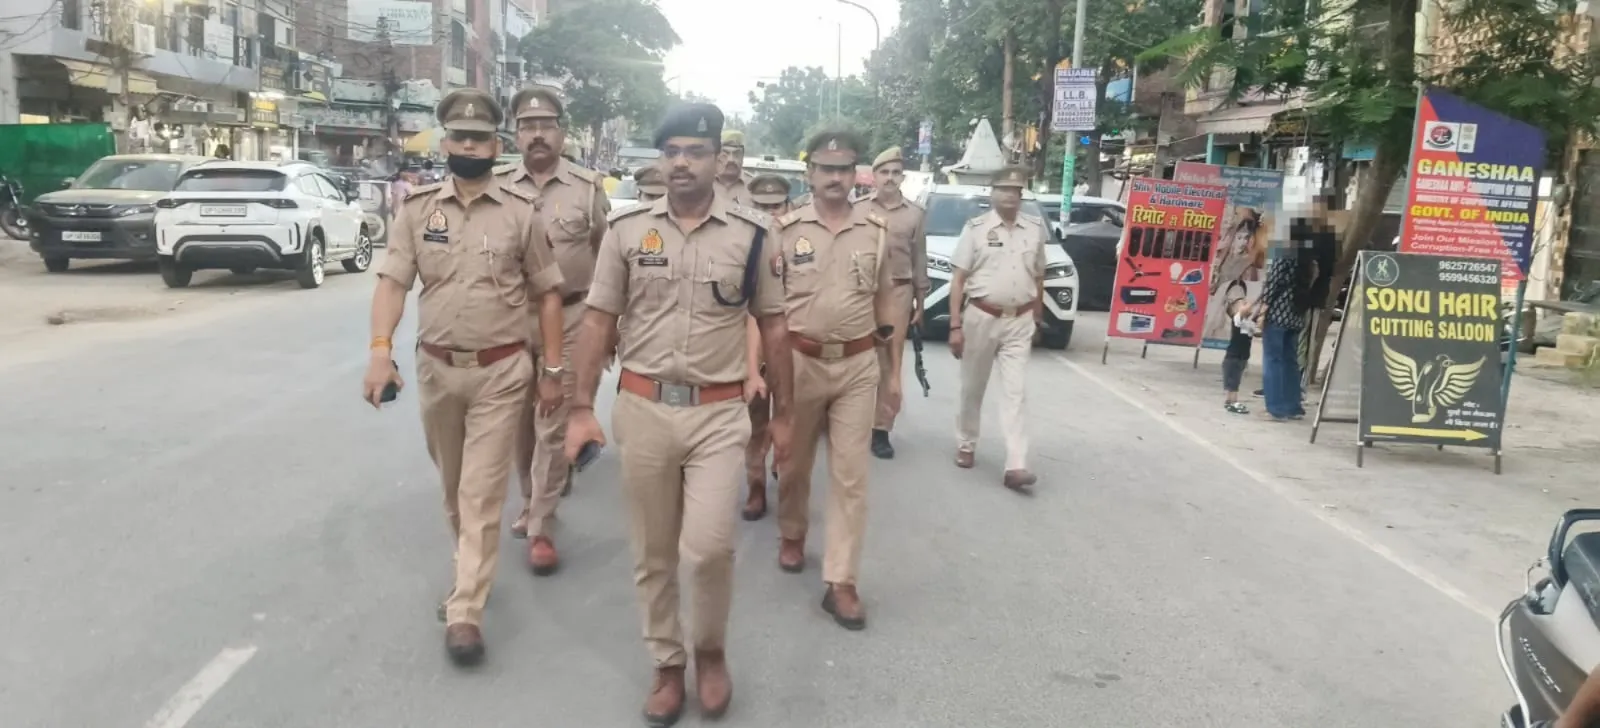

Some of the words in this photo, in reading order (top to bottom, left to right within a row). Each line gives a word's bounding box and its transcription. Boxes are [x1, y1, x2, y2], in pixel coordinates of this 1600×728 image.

[1057, 69, 1096, 77] RELIABLE
[1417, 159, 1534, 182] GANESHAA
[1155, 183, 1182, 195] Mobile
[1184, 185, 1225, 199] Electrical
[1149, 197, 1156, 205] &
[1160, 197, 1205, 208] Hardware
[1132, 205, 1167, 224] रिमोट
[1183, 209, 1217, 229] रिमोट
[1410, 205, 1455, 218] GOVT.
[1460, 208, 1481, 220] OF
[1485, 210, 1530, 223] INDIA
[1411, 234, 1434, 242] Join
[1436, 235, 1455, 243] Our
[1458, 236, 1497, 246] Mission
[1498, 240, 1514, 248] for
[1410, 242, 1491, 255] Corruption-Free
[1493, 247, 1518, 256] India
[1439, 260, 1498, 273] 9625726547
[1438, 272, 1498, 284] 9599456320
[1366, 287, 1431, 313] SONU
[1439, 291, 1498, 321] HAIR
[1370, 316, 1434, 338] CUTTING
[1438, 320, 1495, 342] SALOON
